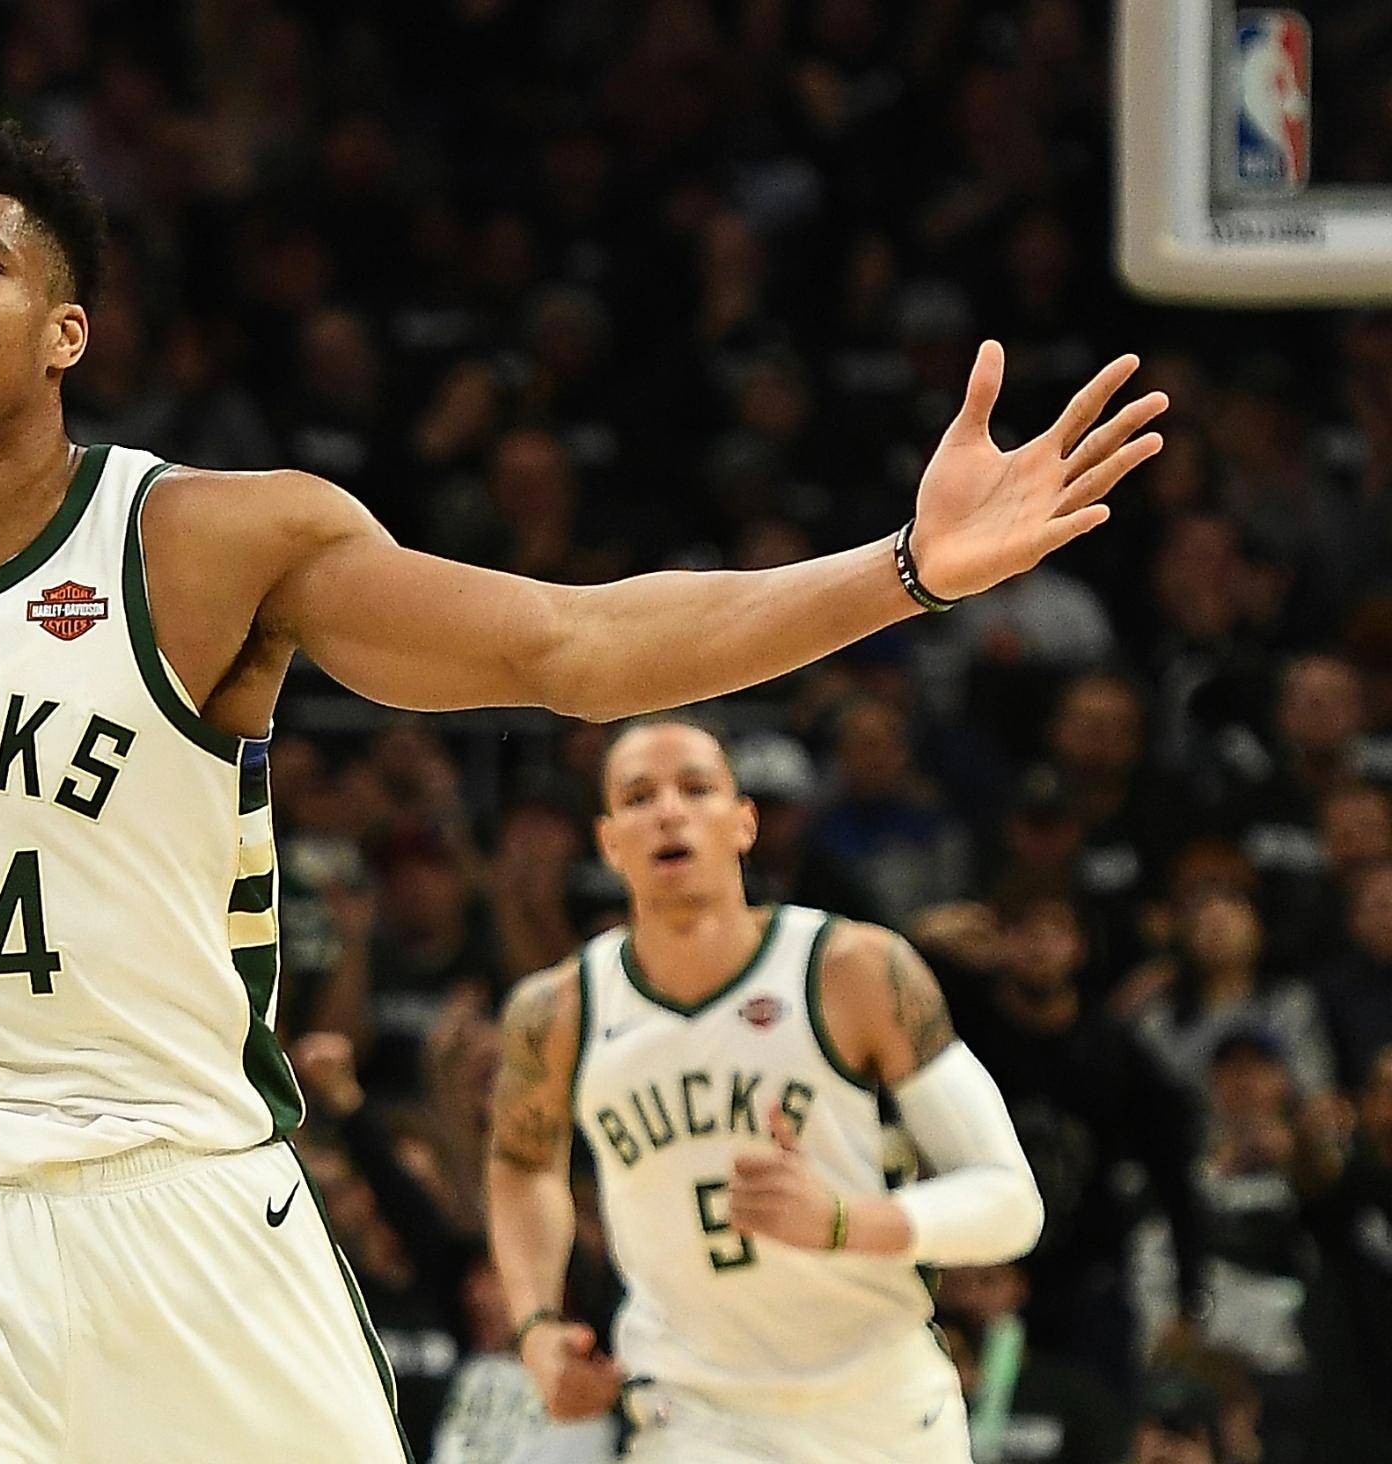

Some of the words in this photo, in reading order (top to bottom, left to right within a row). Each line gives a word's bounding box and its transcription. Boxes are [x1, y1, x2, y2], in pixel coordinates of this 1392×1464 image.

[49, 586, 89, 600] MOTOR
[31, 602, 105, 618] HARLEY-DAVIDSON
[48, 619, 88, 636] CYCLES
[596, 1071, 815, 1167] BUCKS
[694, 1180, 757, 1272] 5
